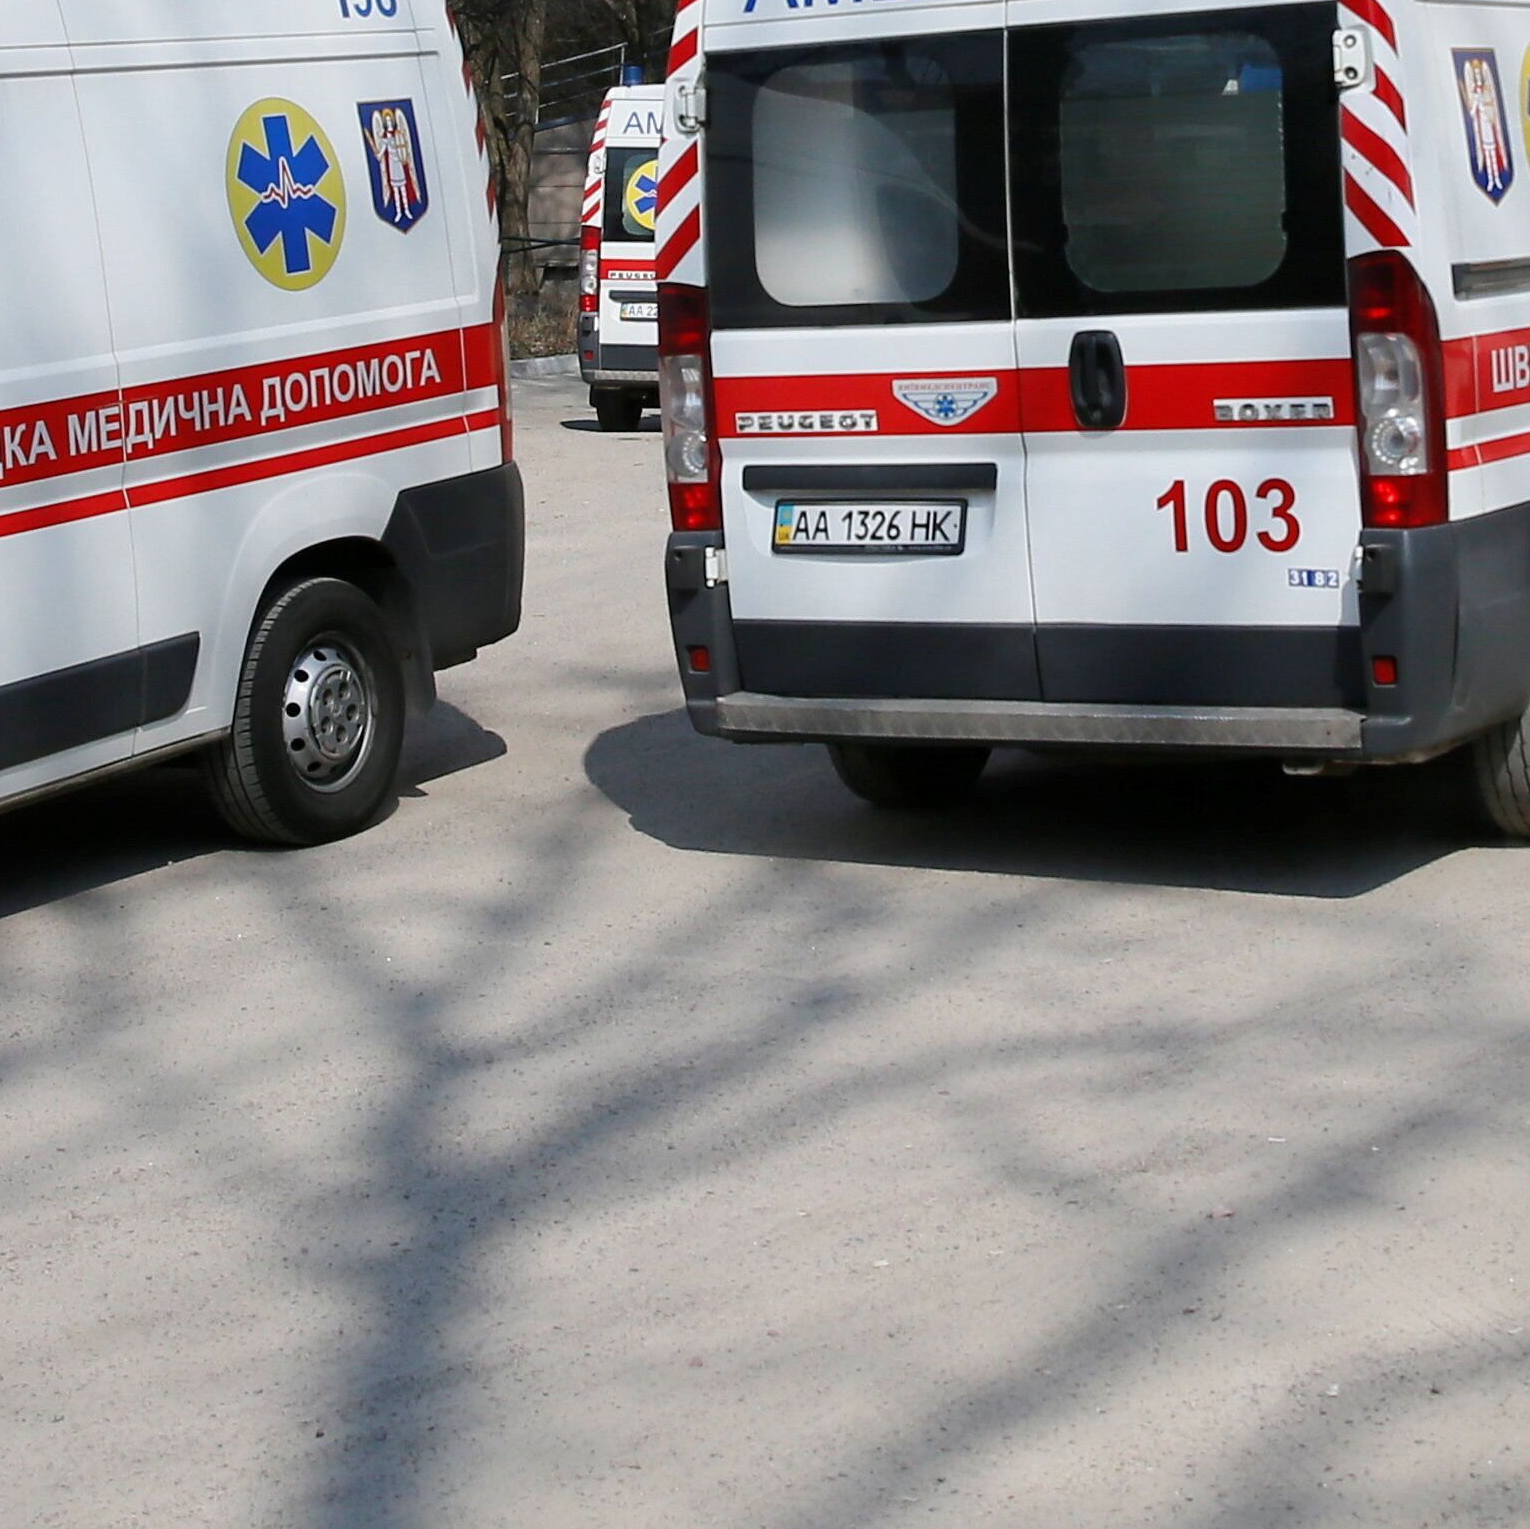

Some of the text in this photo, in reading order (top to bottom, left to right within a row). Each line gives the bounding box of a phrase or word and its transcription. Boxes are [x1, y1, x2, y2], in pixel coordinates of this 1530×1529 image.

[67, 384, 250, 456] МЕДИЧНА
[260, 348, 441, 424] ДОПОМОГА
[1215, 403, 1331, 421] BOXER
[737, 413, 875, 431] PEUGEOT
[793, 510, 952, 542] AA 1326 HK
[1156, 478, 1301, 553] 103
